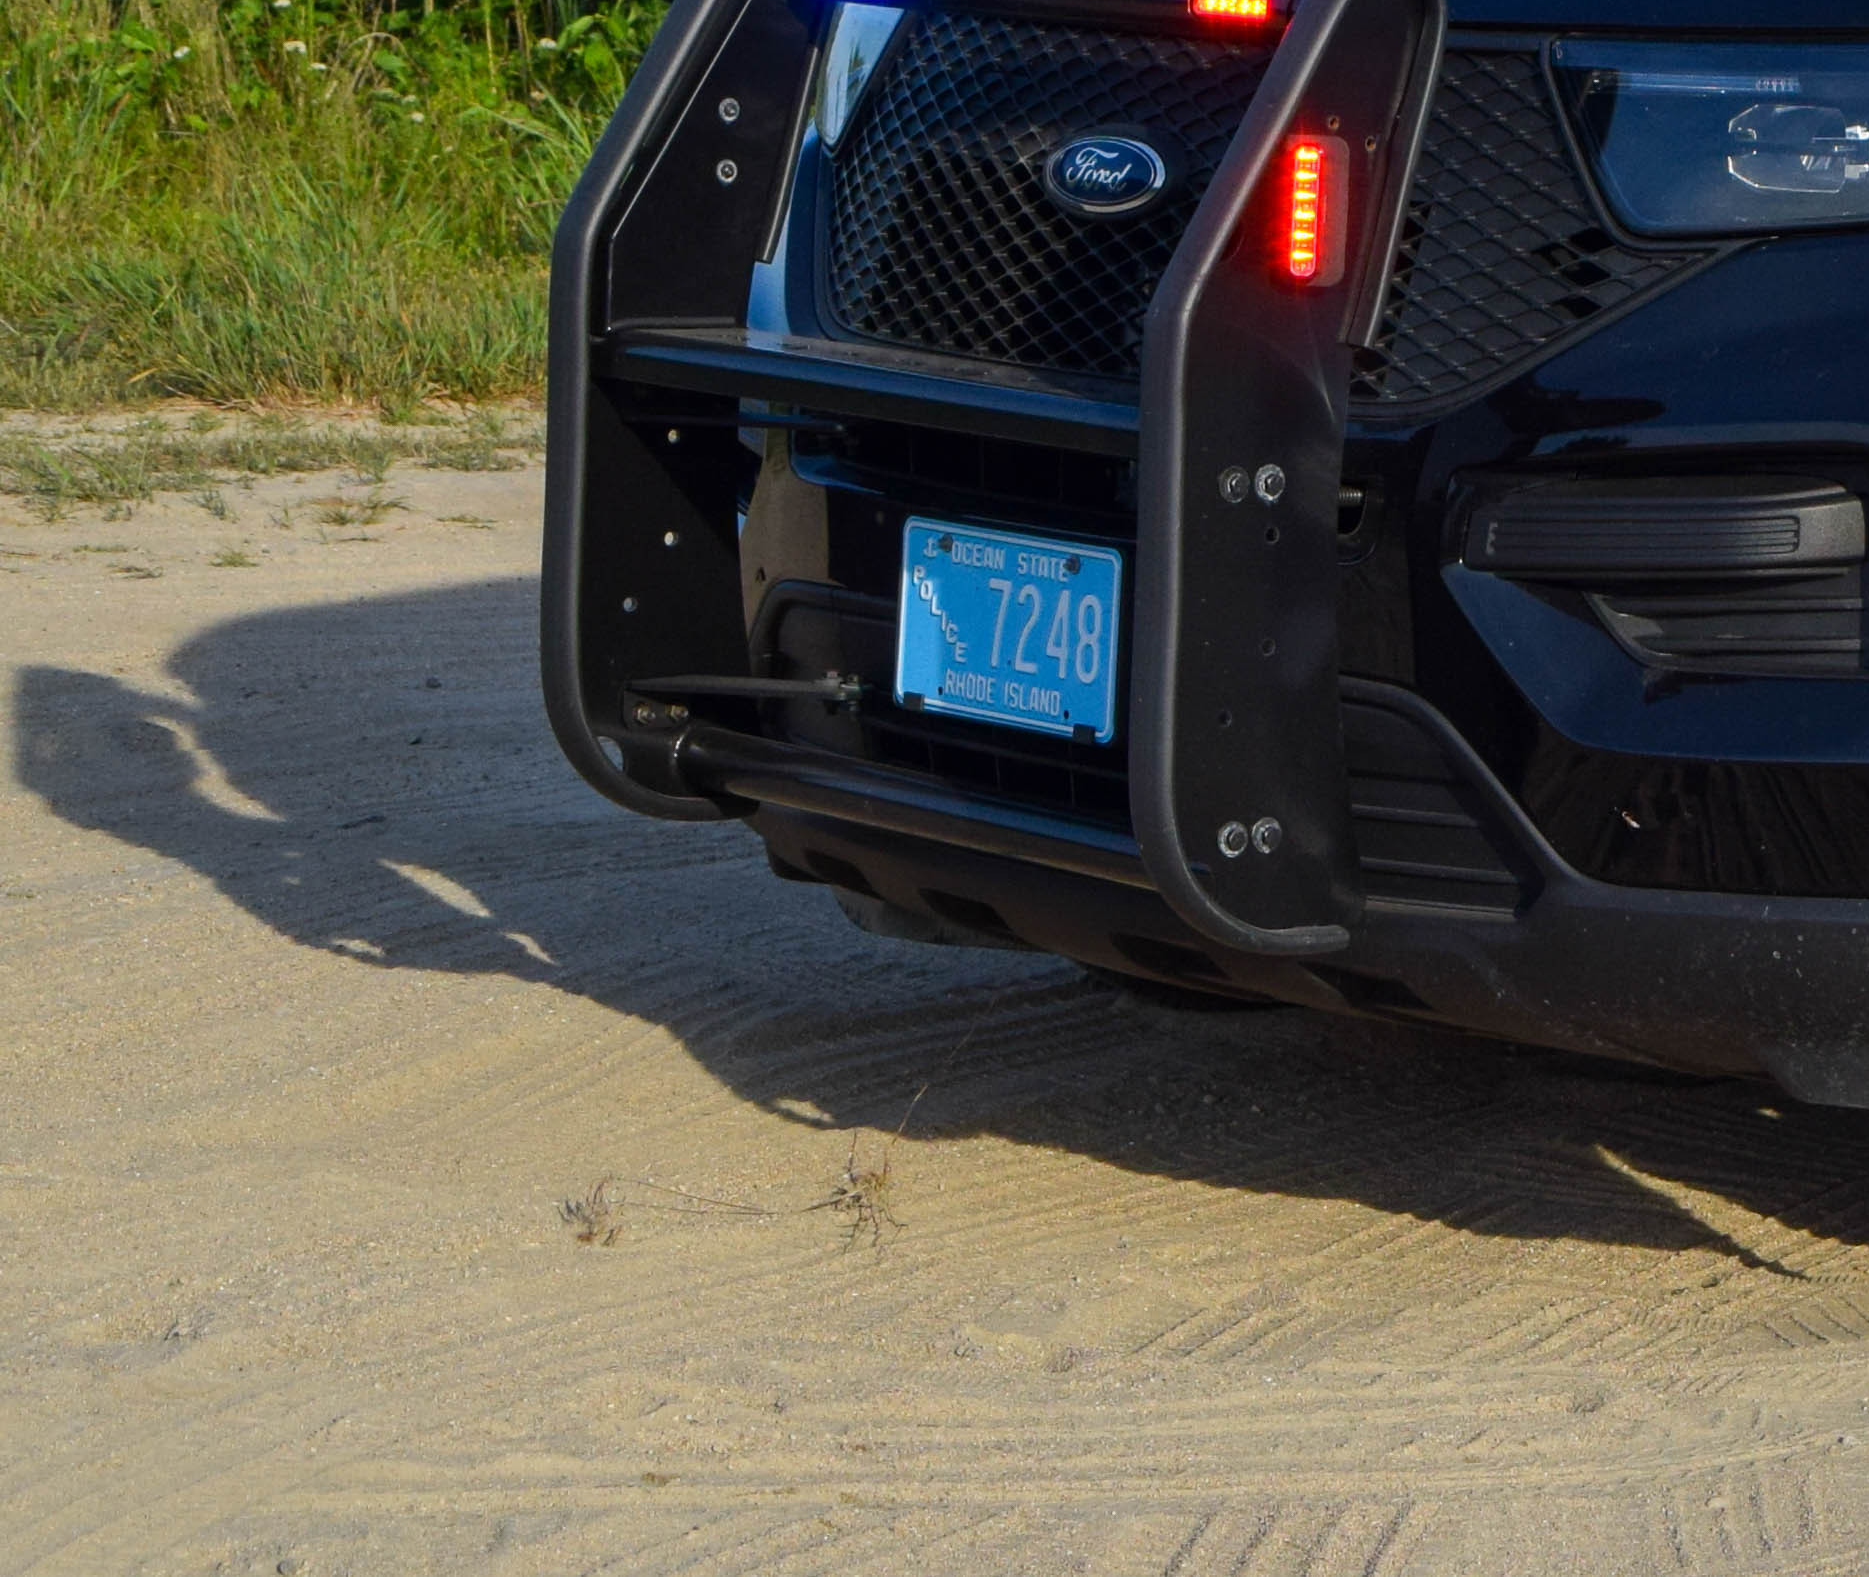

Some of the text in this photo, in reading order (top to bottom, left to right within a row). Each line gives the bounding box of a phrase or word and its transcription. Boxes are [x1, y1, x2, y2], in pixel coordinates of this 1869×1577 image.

[1066, 147, 1131, 187] Ford
[952, 540, 1070, 583] OCEAN STATE
[912, 564, 968, 663] POLICE
[988, 577, 1101, 685] 7248
[946, 668, 1061, 717] RHODE ISLAND
